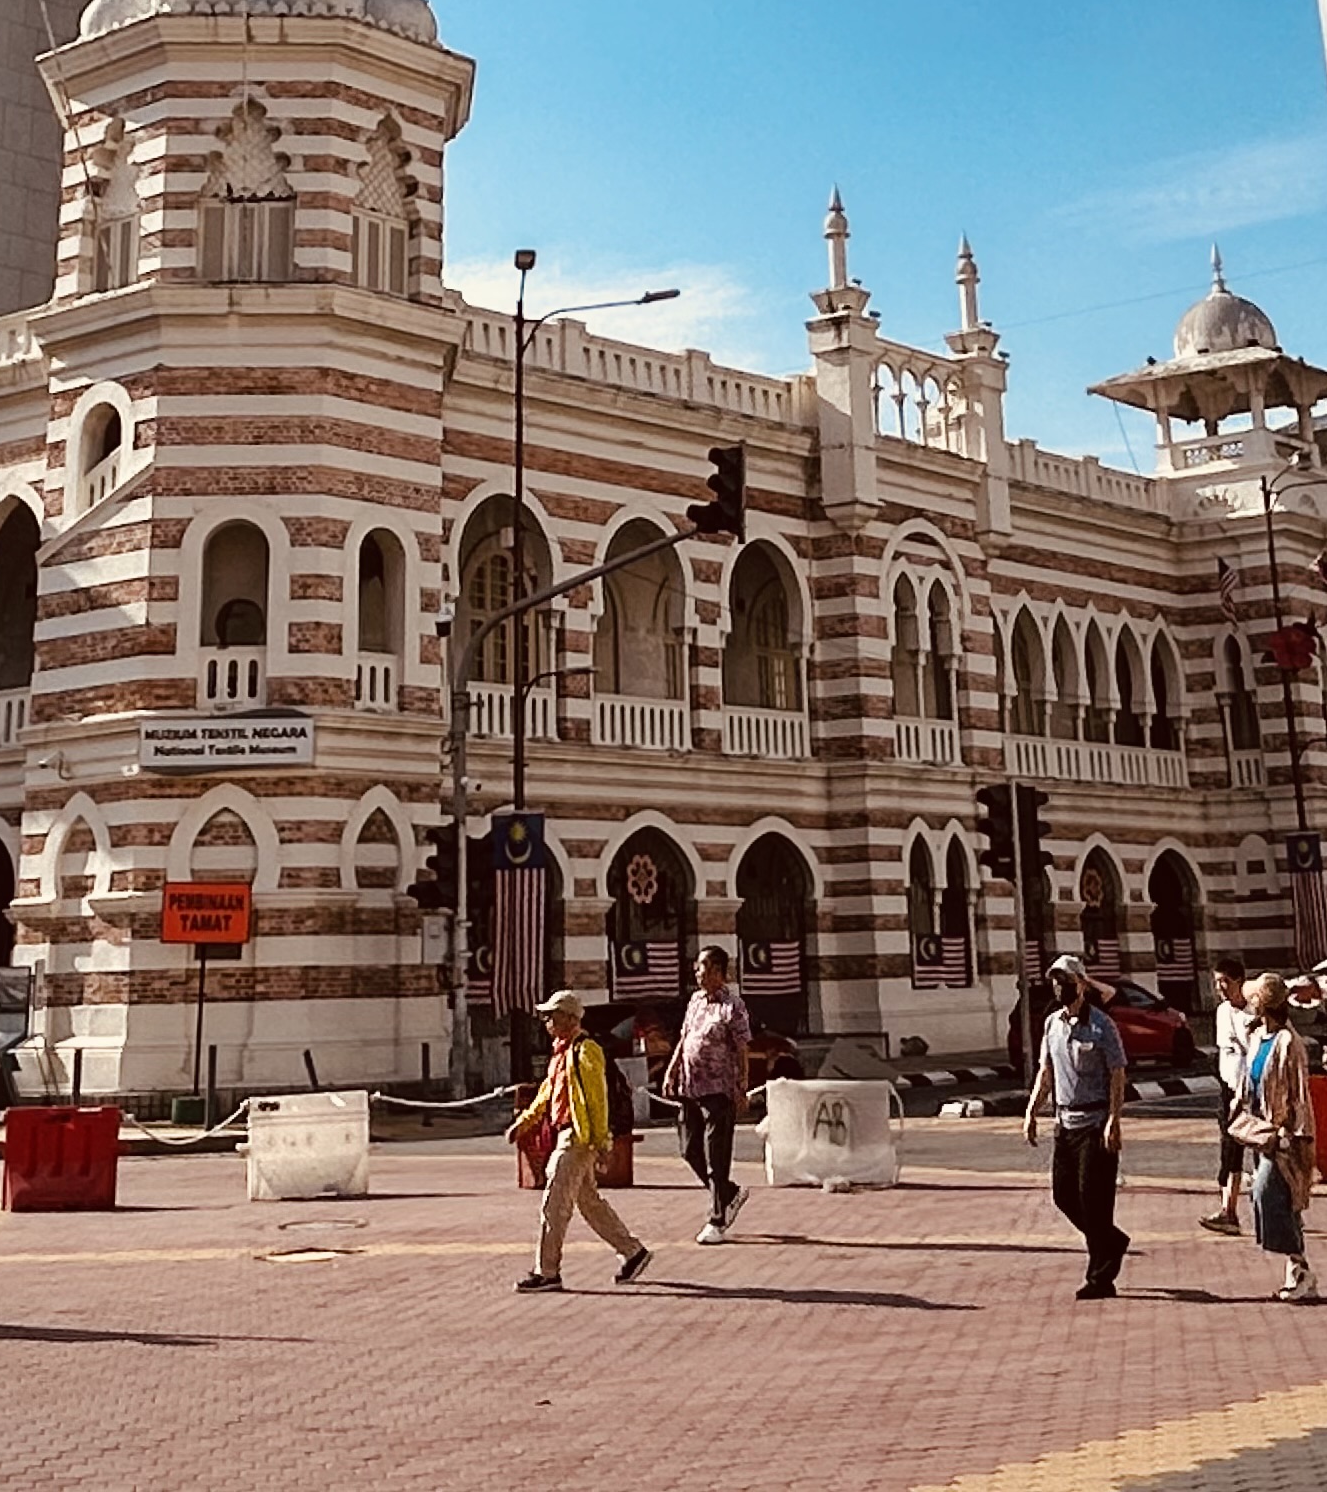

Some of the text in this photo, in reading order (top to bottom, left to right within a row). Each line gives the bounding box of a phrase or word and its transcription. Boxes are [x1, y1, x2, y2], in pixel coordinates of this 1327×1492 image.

[251, 727, 307, 738] NEGARA
[153, 744, 297, 756] National Textile Museum
[179, 914, 232, 932] TAMAT
